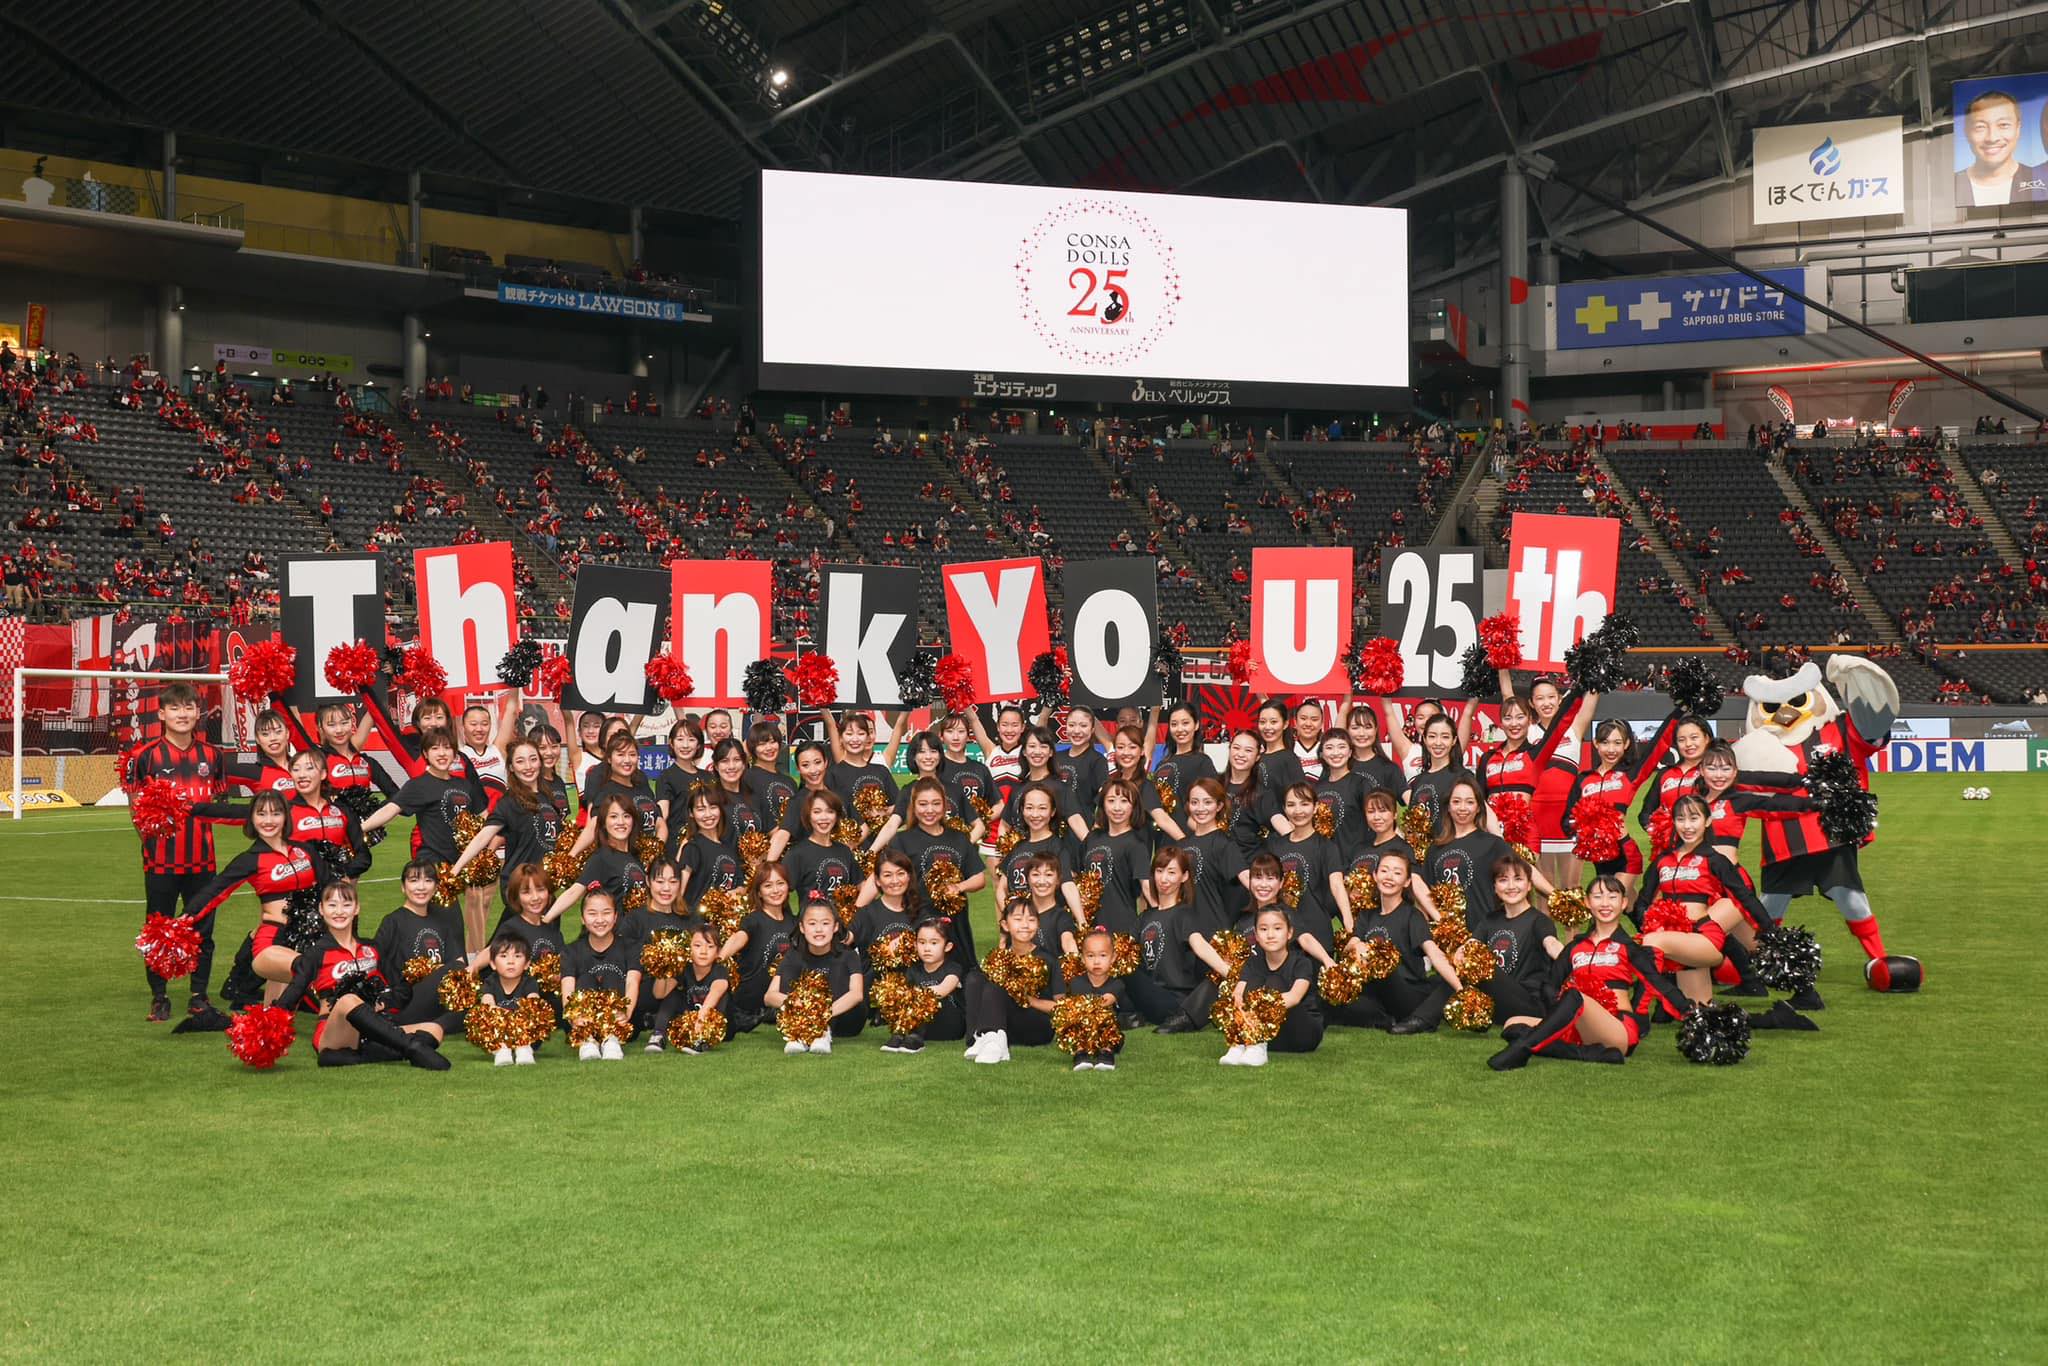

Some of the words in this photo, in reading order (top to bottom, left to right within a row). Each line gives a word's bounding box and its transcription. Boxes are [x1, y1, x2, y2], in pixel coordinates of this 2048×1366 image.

[1768, 178, 1889, 206] ほくでんガス
[1066, 233, 1131, 249] CONSA
[1067, 249, 1130, 265] DOLLS
[505, 286, 575, 306] 観戦チケットは
[579, 293, 660, 317] LAWSON
[1682, 283, 1784, 312] サツドラ
[1683, 315, 1725, 327] SAPPORO
[1728, 312, 1753, 324] DRUG
[1756, 310, 1784, 321] STORE
[1070, 326, 1130, 336] ANNIVERSARY
[974, 380, 1057, 398] エナジティック
[643, 811, 655, 826] 25
[545, 821, 557, 838] 25
[720, 873, 734, 890] 25
[1013, 868, 1026, 886] 25
[1444, 867, 1459, 885] 25
